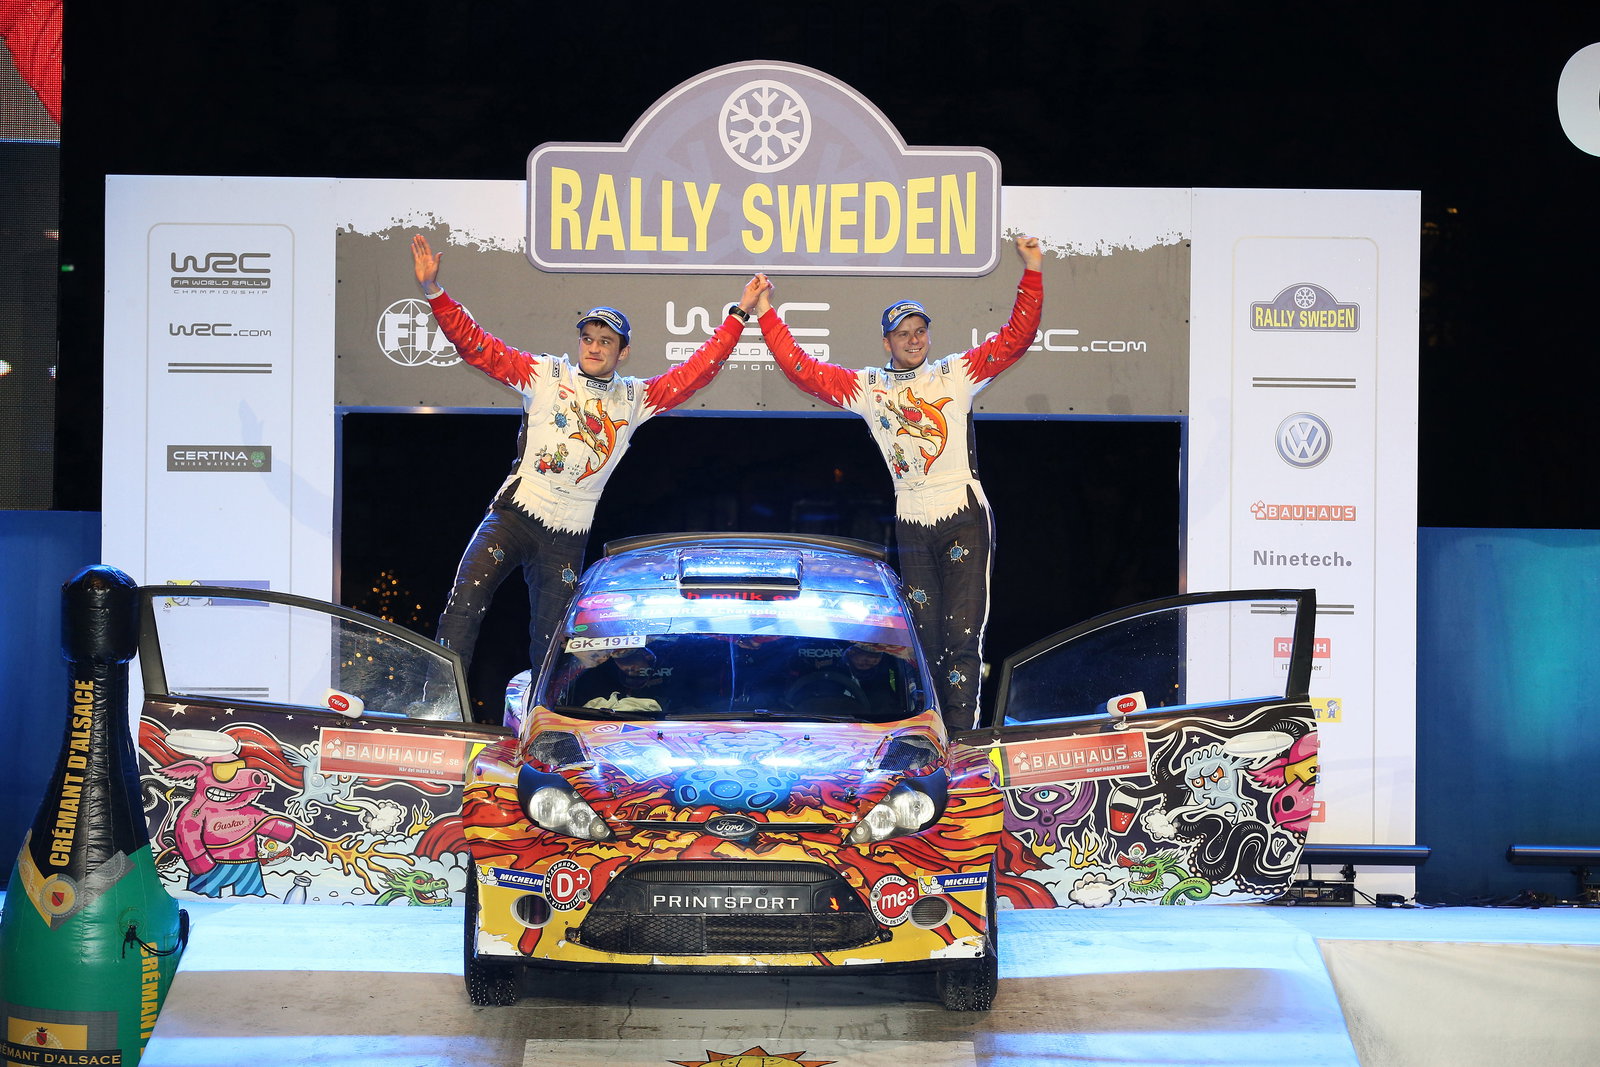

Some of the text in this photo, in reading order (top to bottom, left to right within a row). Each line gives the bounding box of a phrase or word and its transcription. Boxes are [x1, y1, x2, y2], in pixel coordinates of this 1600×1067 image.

[550, 166, 976, 255] RALLY SWEDEN
[171, 252, 271, 273] WRC
[1255, 307, 1355, 328] RALLY SWEDEN
[173, 451, 248, 460] CERTINA
[1267, 506, 1355, 518] BAUHAUS
[711, 591, 763, 601] milk
[569, 636, 641, 650] GK-1913
[49, 679, 94, 867] CRÉMANT D'ALSACE
[716, 820, 744, 831] Ford
[499, 873, 544, 886] MICHELIN
[653, 895, 800, 909] PRINTSPORT
[0, 1043, 121, 1065] ÉMANT D'ALSACE
